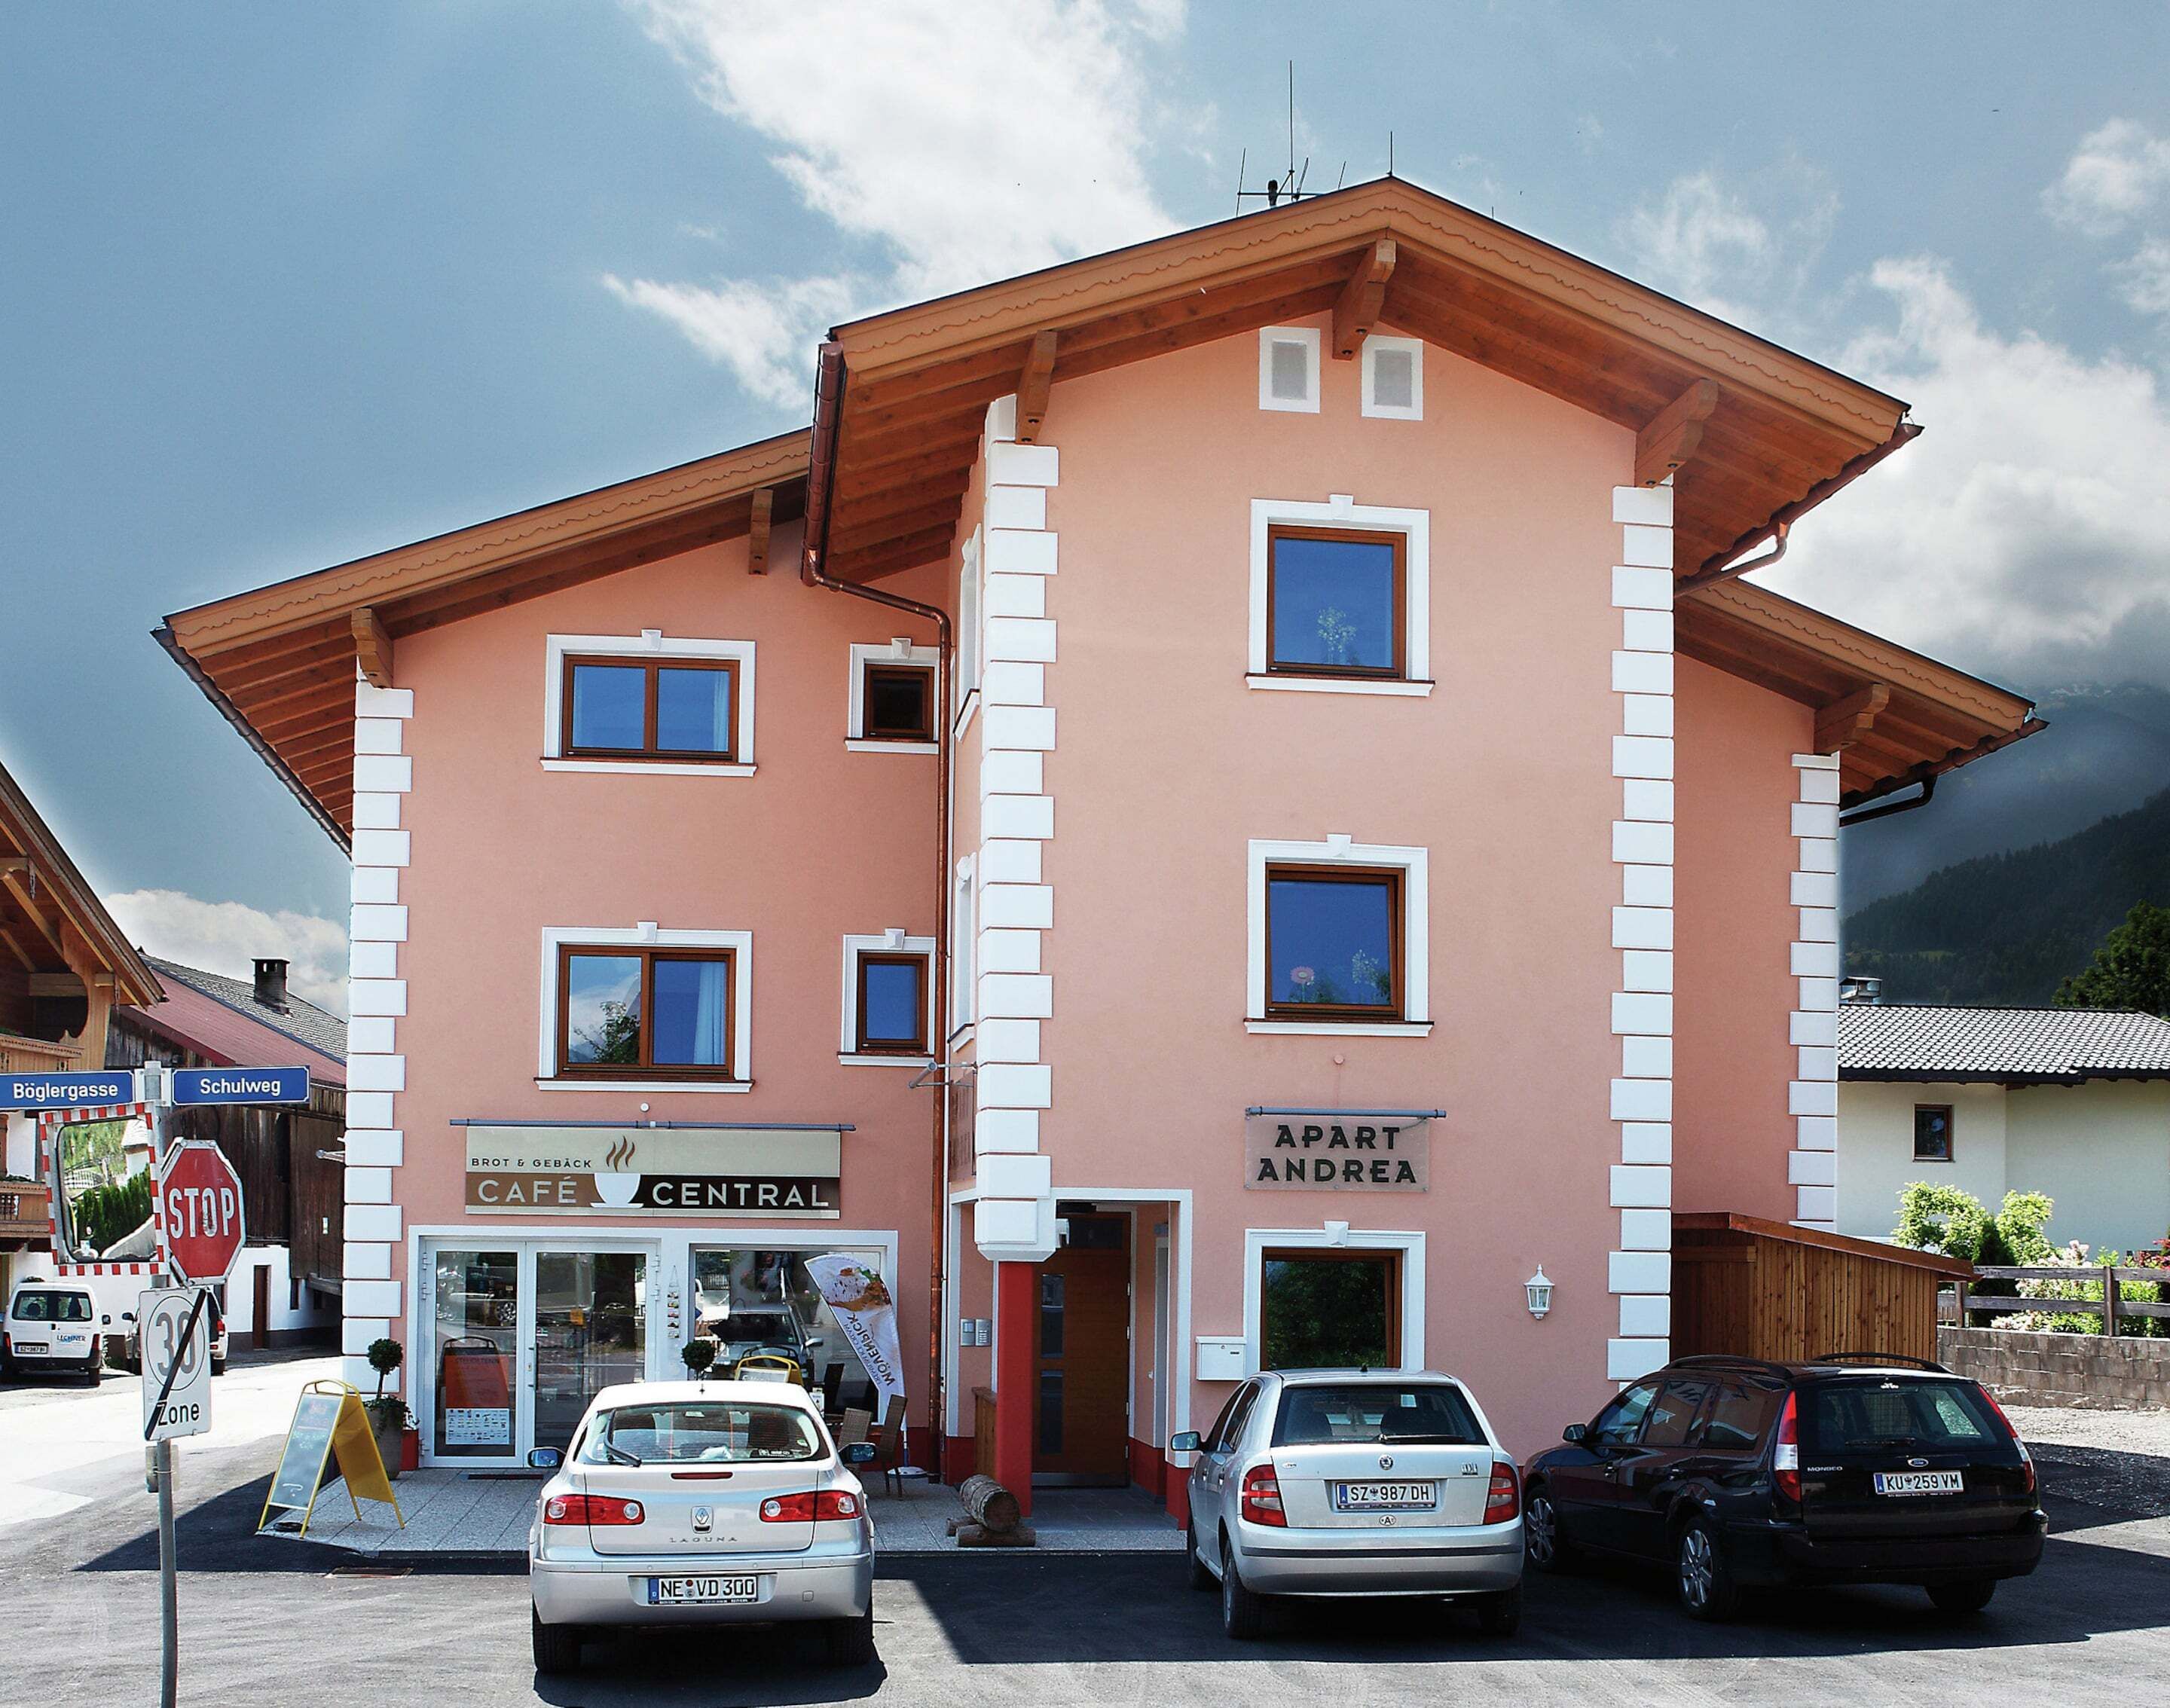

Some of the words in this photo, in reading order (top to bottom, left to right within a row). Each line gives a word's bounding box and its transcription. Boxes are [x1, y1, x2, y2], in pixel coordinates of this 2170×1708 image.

[13, 1082, 118, 1102] Böglergasse
[200, 1077, 281, 1097] Schulweg
[1275, 1124, 1400, 1150] APART
[472, 1158, 509, 1167] BROT
[517, 1158, 525, 1167] &
[533, 1158, 591, 1168] GEBÄCK
[1257, 1157, 1417, 1184] ANDREA
[478, 1176, 578, 1204] CAFÉ
[651, 1181, 830, 1207] CENTRAL
[169, 1187, 235, 1239] STOP
[156, 1311, 196, 1376] 30
[157, 1401, 200, 1426] Zone
[1887, 1476, 1904, 1490] KU
[1914, 1474, 1939, 1490] 259
[1942, 1474, 1960, 1489] VM
[1350, 1486, 1368, 1501] SZ
[1380, 1486, 1407, 1500] 987
[1410, 1486, 1429, 1500] DH
[660, 1581, 683, 1597] NE
[695, 1580, 719, 1596] VD
[723, 1579, 754, 1596] 300
